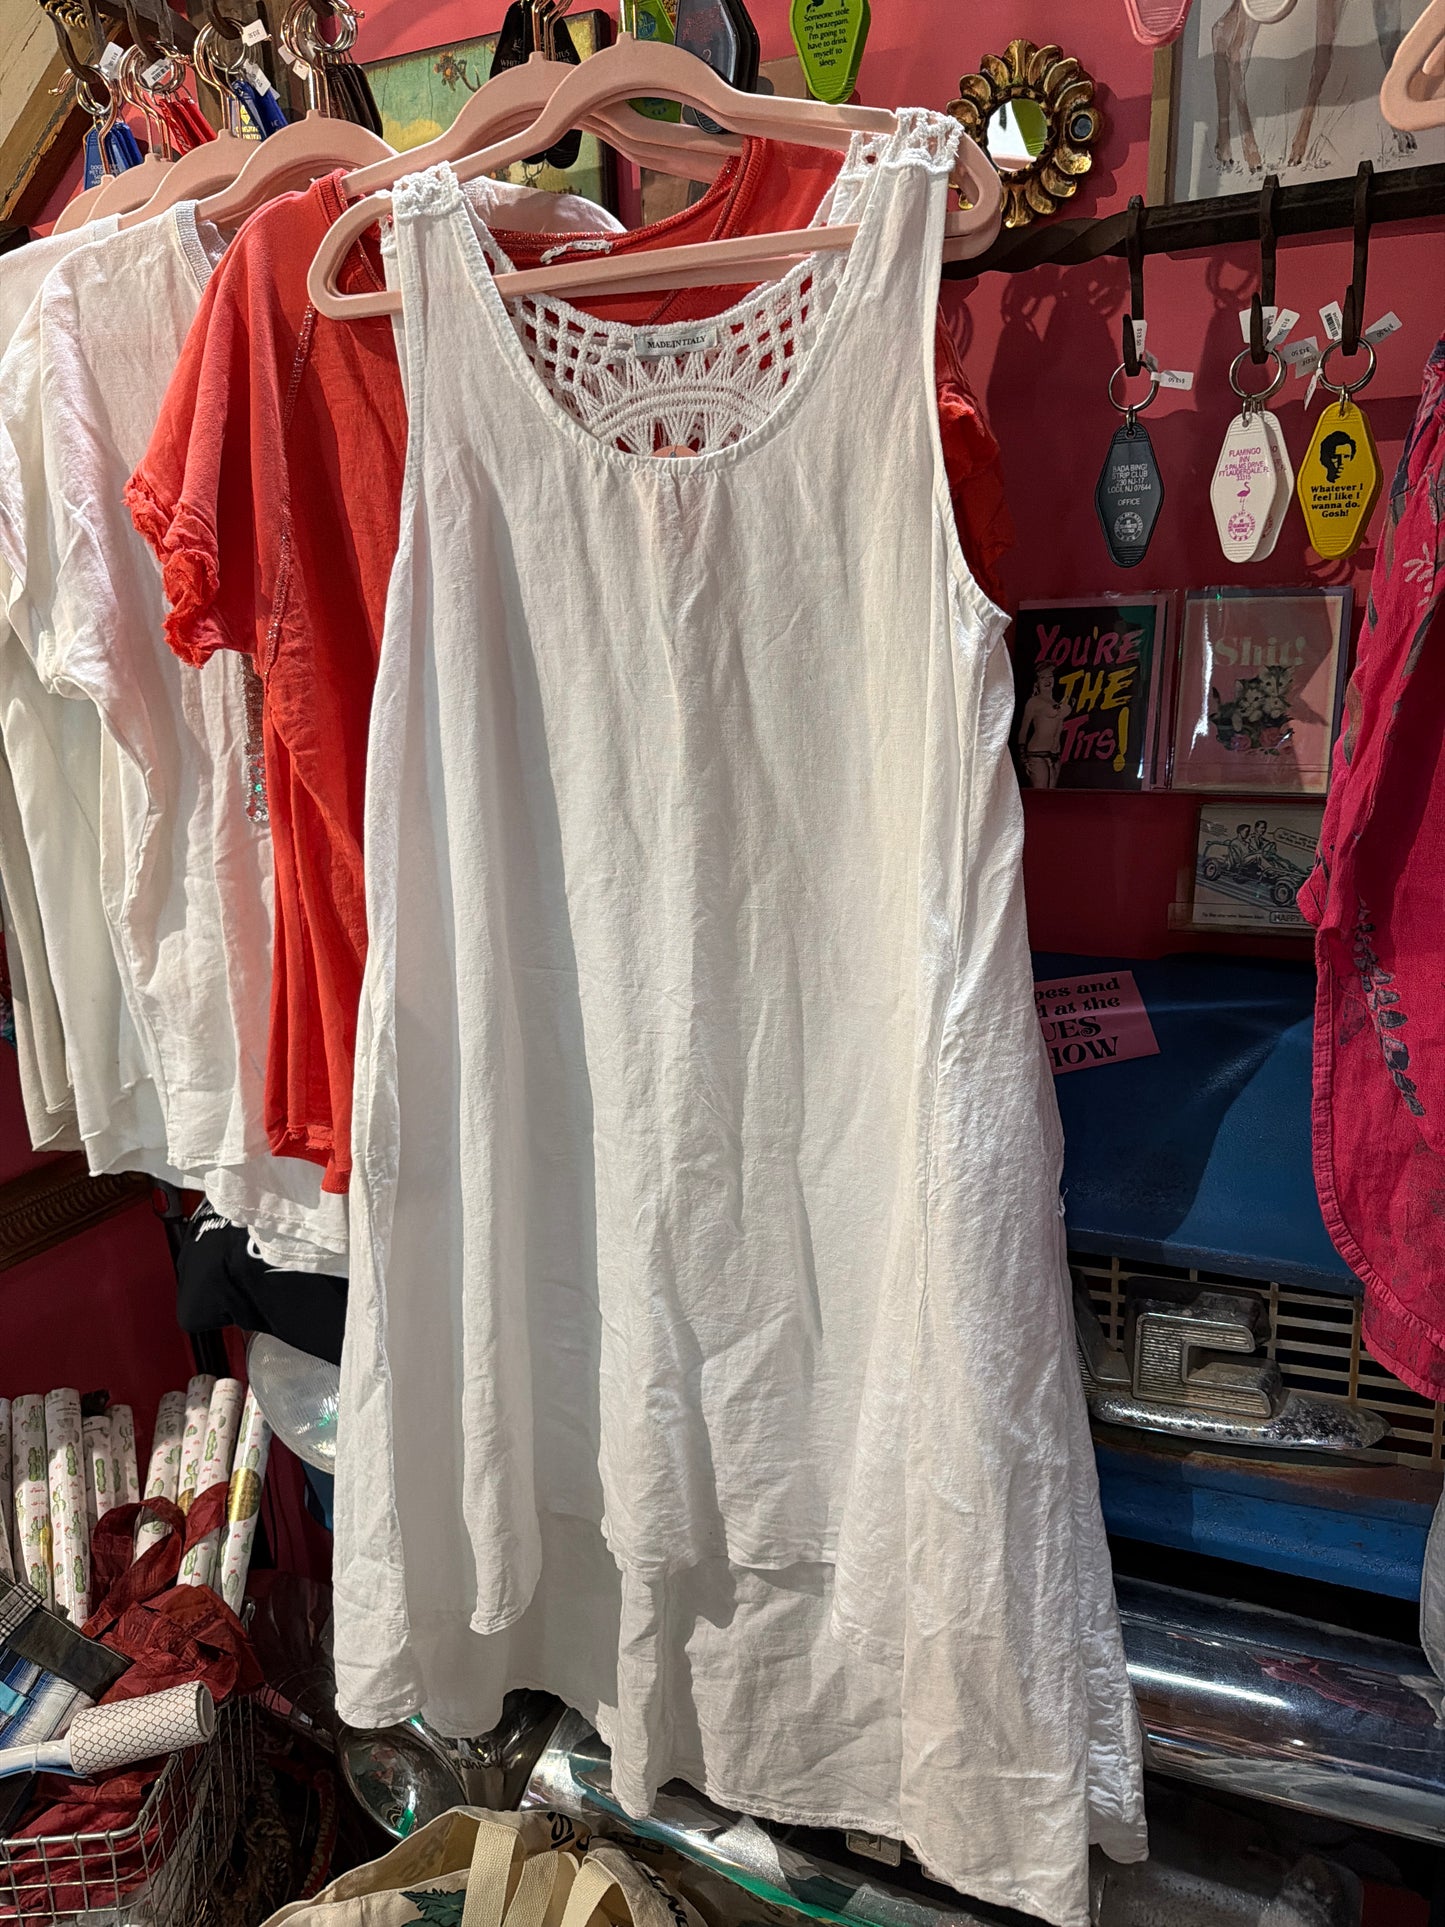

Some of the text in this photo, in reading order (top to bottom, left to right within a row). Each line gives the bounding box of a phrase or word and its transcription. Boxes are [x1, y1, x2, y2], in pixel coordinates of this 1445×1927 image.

[804, 8, 850, 22] Someone stole
[804, 24, 814, 32] my
[820, 29, 837, 40] going
[813, 48, 834, 59] myself
[647, 335, 707, 349] MADE IN ITALY
[1229, 447, 1261, 457] FLAMINGO
[1112, 470, 1148, 480] STRIP CLUB
[1311, 485, 1357, 493] Whatever
[1313, 493, 1332, 501] feel
[1335, 492, 1353, 500] like
[1118, 498, 1141, 506] OFFICE
[1312, 502, 1342, 510] wanna
[1322, 509, 1349, 518] Gosh!
[1213, 636, 1306, 666] Shit!
[1058, 666, 1138, 713] THE
[1077, 978, 1120, 994] and
[1055, 1002, 1077, 1016] at
[1082, 997, 1121, 1011] the
